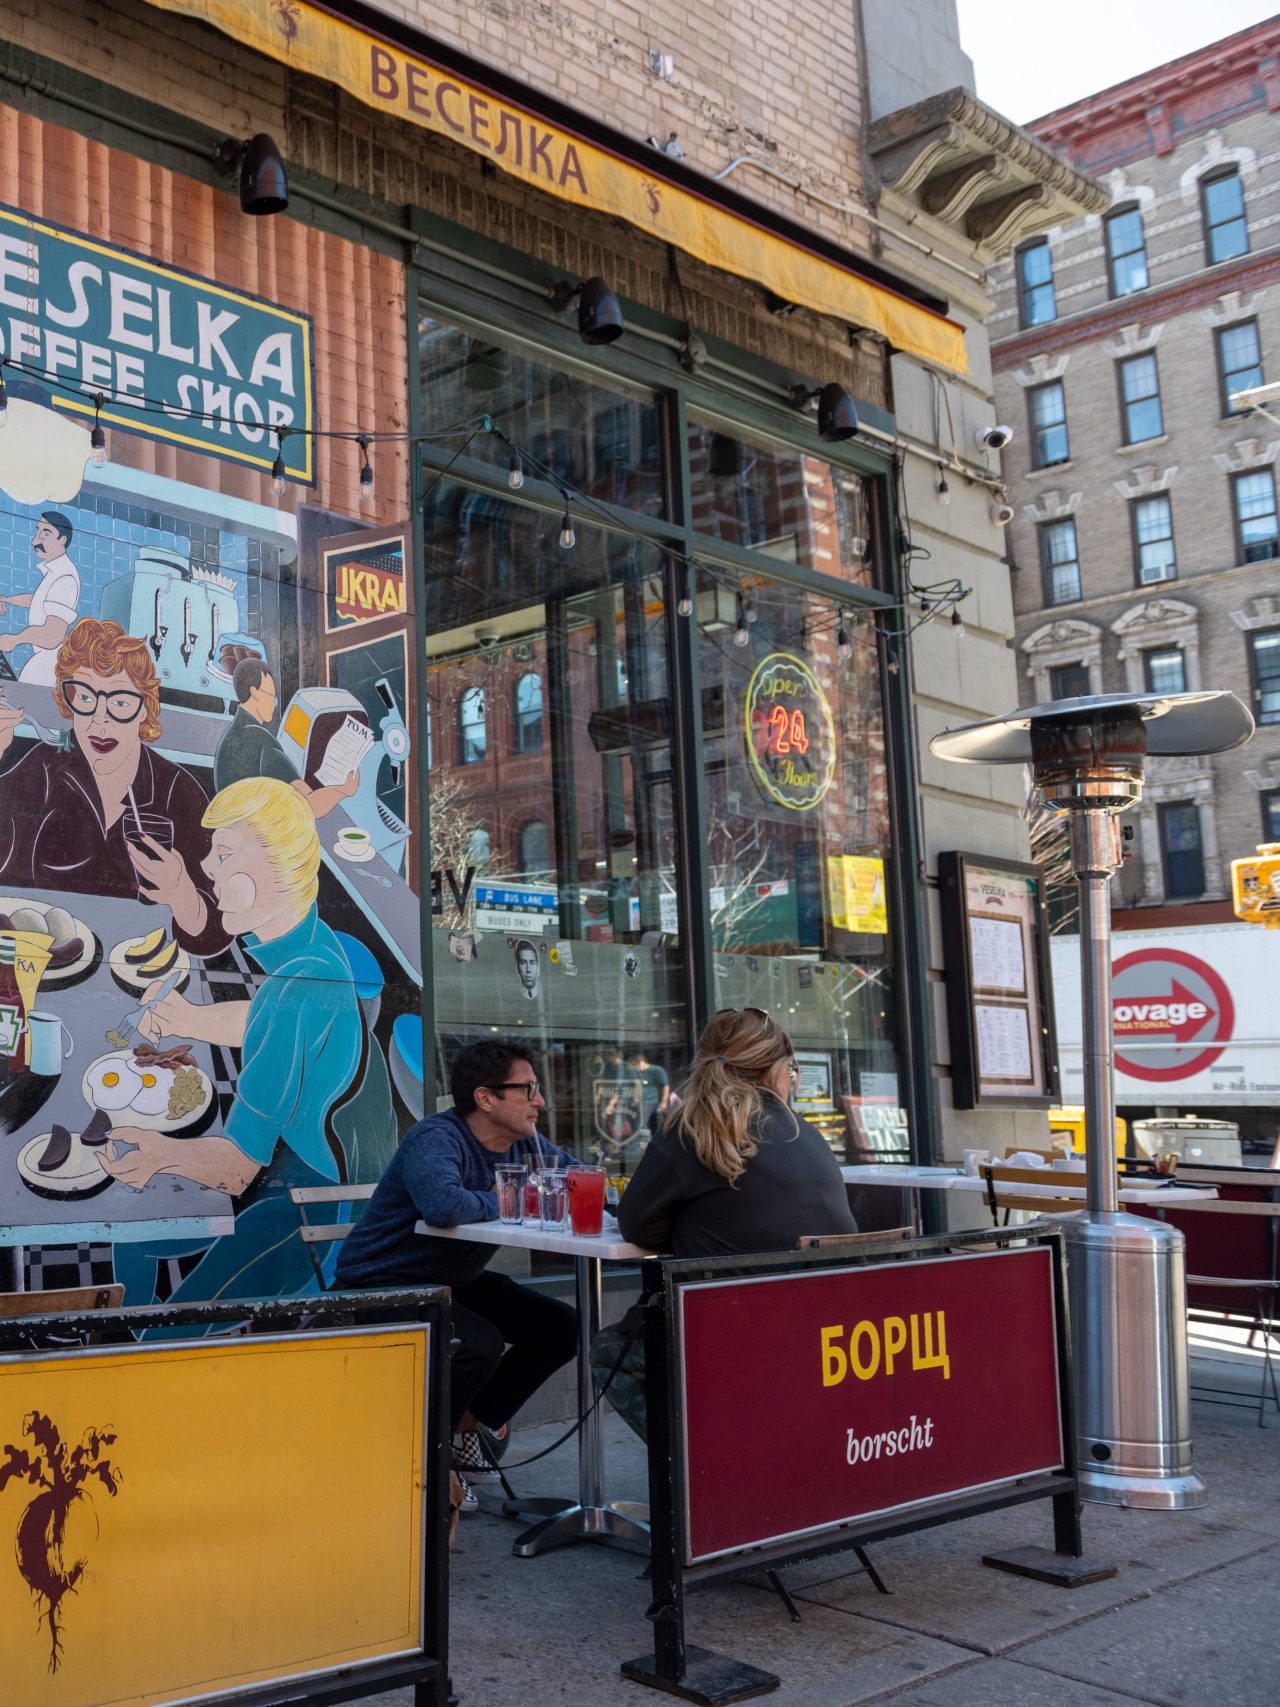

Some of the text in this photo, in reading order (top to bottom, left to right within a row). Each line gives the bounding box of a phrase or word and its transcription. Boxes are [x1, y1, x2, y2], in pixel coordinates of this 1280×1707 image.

[371, 44, 588, 194] ВЕСЕЛКА
[163, 374, 295, 451] SHOP
[770, 705, 809, 754] 24
[504, 892, 542, 906] BUS LANE
[514, 916, 532, 928] ONLY
[1113, 1001, 1208, 1026] ovage
[821, 1310, 950, 1387] БОРЩ
[846, 1415, 934, 1465] borscht
